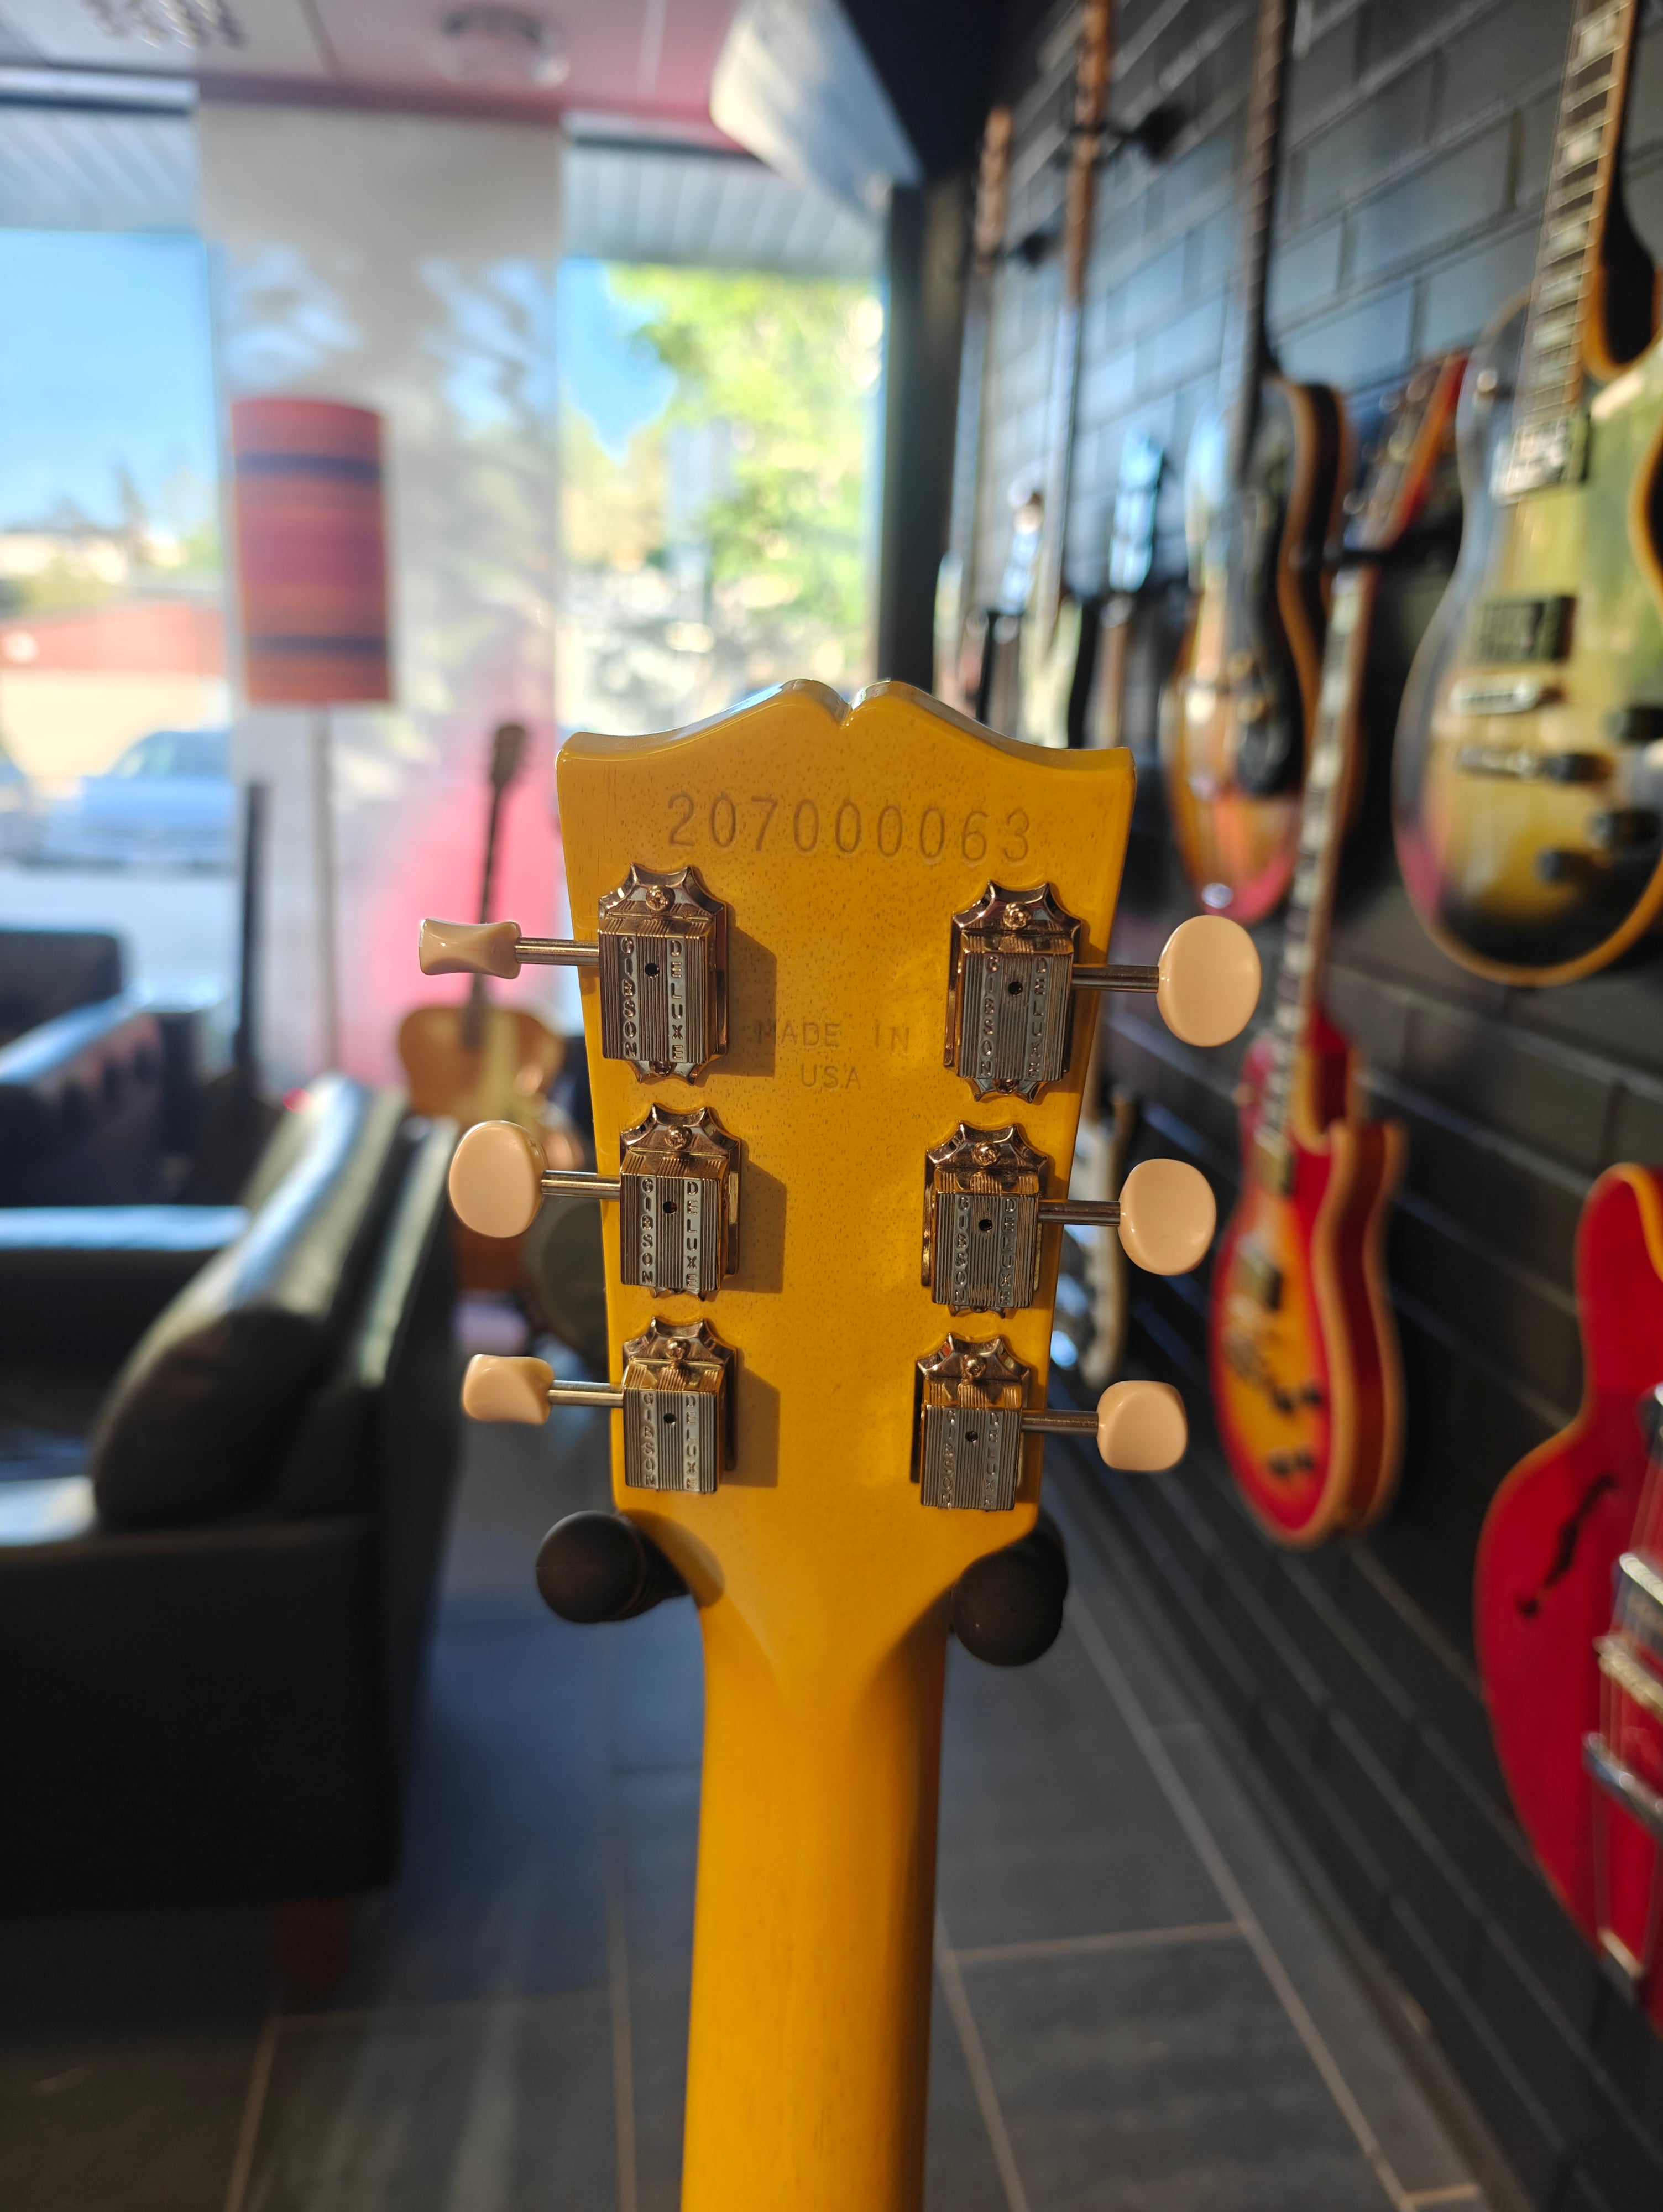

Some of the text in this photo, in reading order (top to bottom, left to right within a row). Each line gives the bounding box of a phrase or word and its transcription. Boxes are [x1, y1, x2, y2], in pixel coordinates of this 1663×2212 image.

[667, 791, 1029, 862] 207000063
[620, 937, 637, 1059] GIBSON
[671, 940, 684, 1061] DELUXE
[757, 1018, 911, 1053] MADE IN
[980, 956, 999, 1077] GIBSON
[1028, 957, 1048, 1079] DELUXE
[800, 1063, 862, 1090] USA
[642, 1178, 654, 1284] GIBSON
[686, 1181, 698, 1287] DELUXE
[955, 1196, 969, 1303] GIBSON
[1000, 1198, 1015, 1305] DELUXE
[641, 1392, 655, 1487] GIBSON
[686, 1395, 697, 1490] DELUXE
